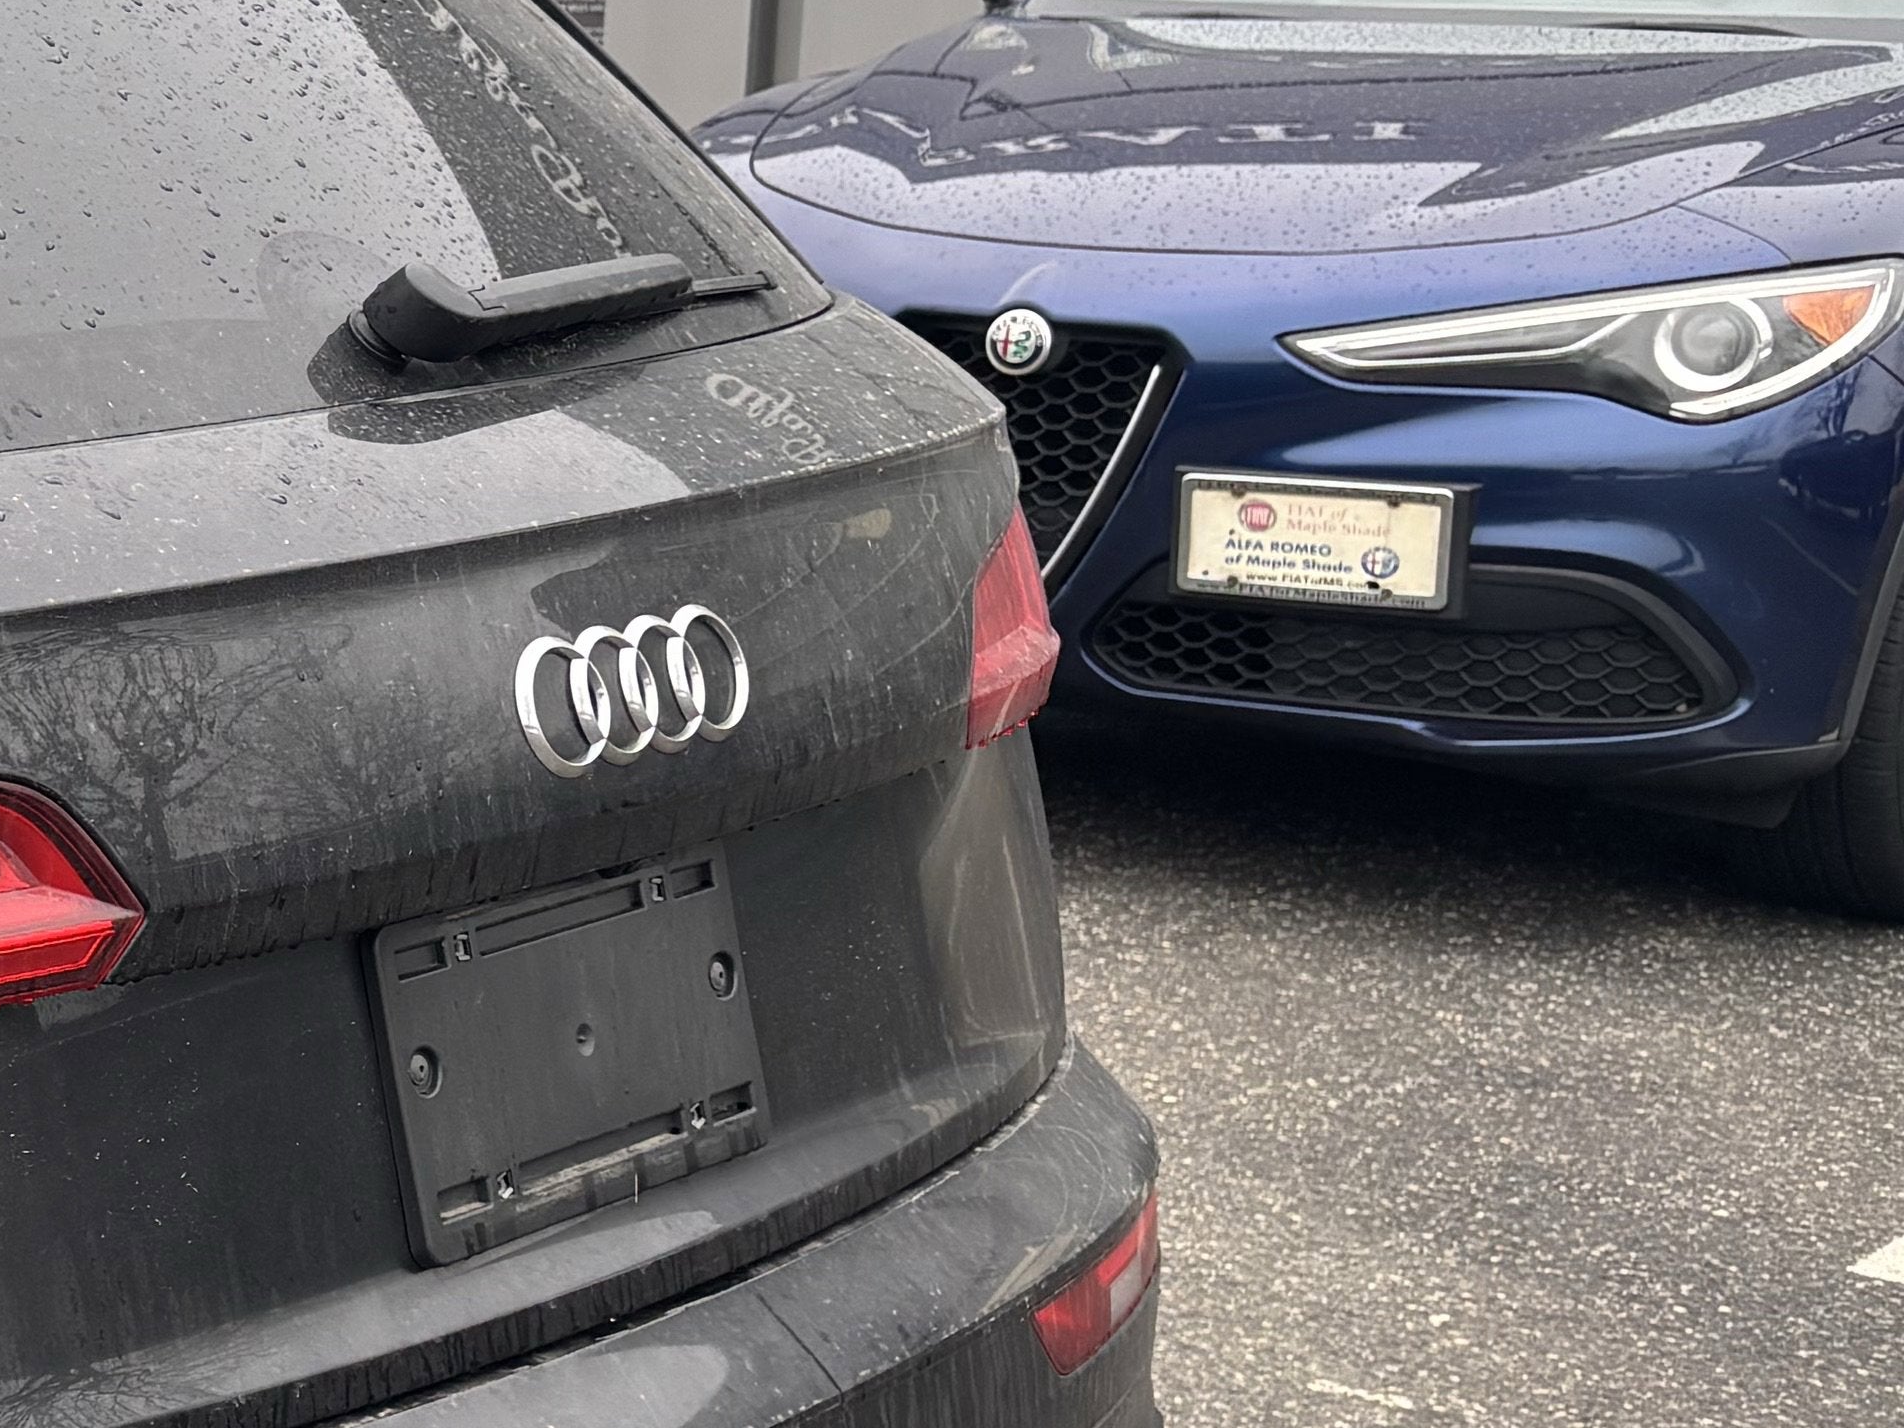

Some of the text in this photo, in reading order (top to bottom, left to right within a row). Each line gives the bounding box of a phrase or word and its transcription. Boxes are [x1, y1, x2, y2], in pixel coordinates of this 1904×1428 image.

[1225, 537, 1332, 557] ALFA ROMEO
[1224, 553, 1353, 574] of Maple Shade
